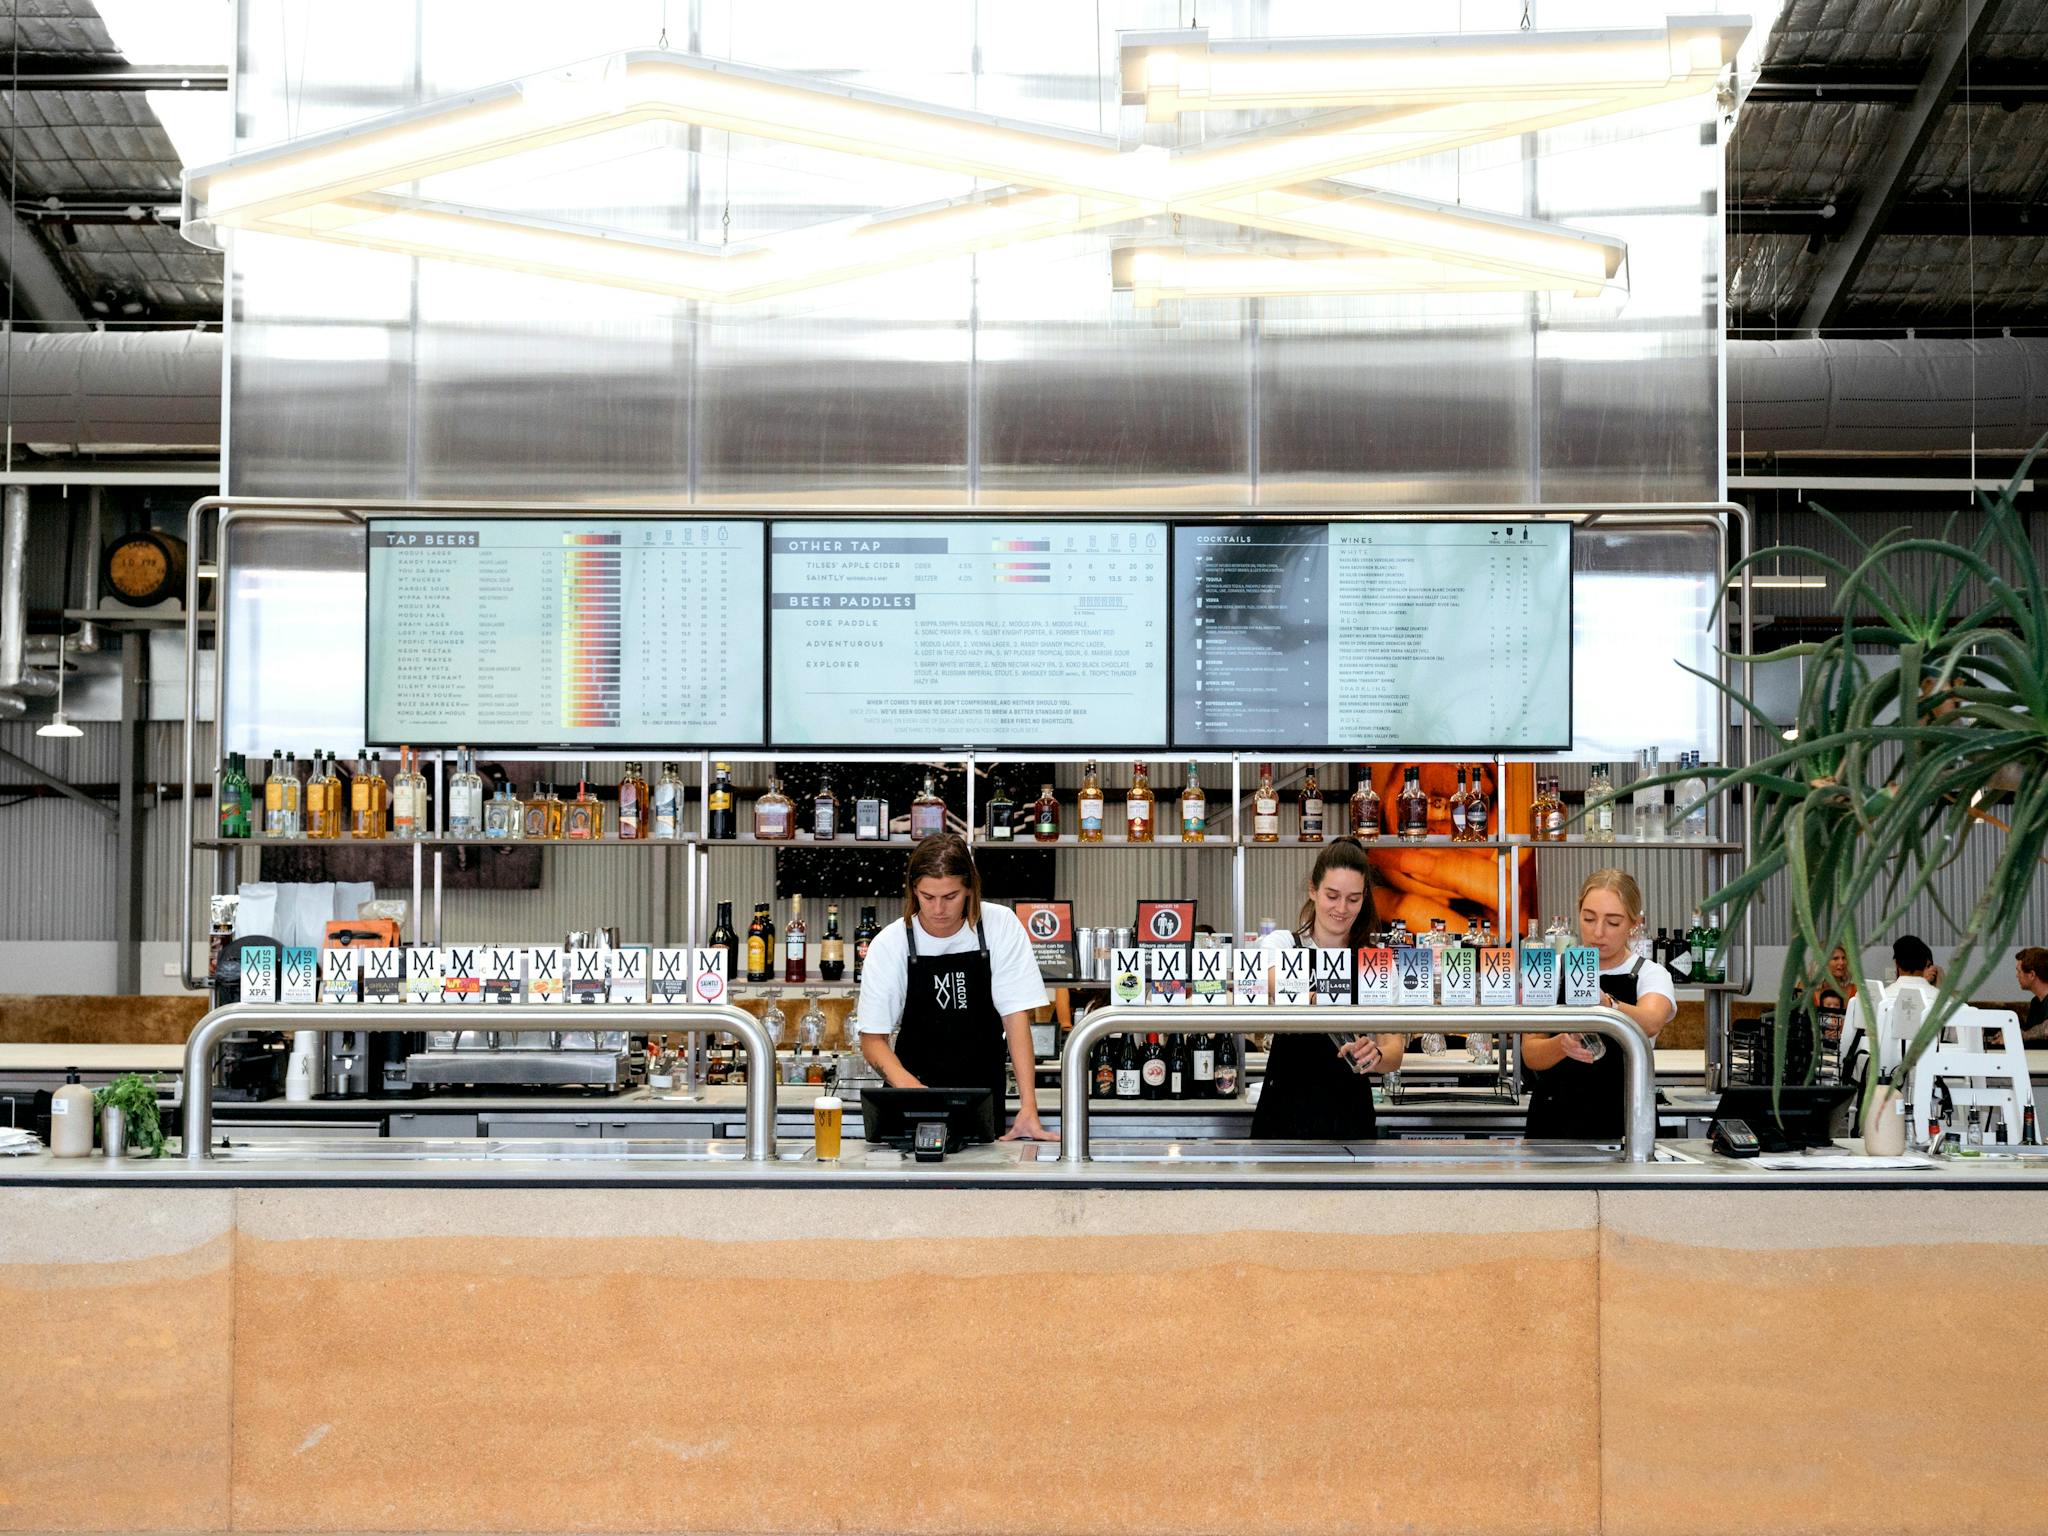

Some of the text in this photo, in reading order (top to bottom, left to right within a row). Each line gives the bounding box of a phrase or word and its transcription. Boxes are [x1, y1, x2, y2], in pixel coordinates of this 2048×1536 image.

[387, 535, 475, 545] TAP BEERS
[789, 541, 881, 551] OTHER TAP
[790, 597, 911, 607] BEER PADDLES
[263, 950, 271, 986] MODUS
[303, 950, 312, 987] MODUS
[1380, 951, 1388, 989] MODUS
[1463, 951, 1471, 989] MODUS
[1587, 950, 1595, 988] MODUS
[956, 972, 967, 1009] MODUS
